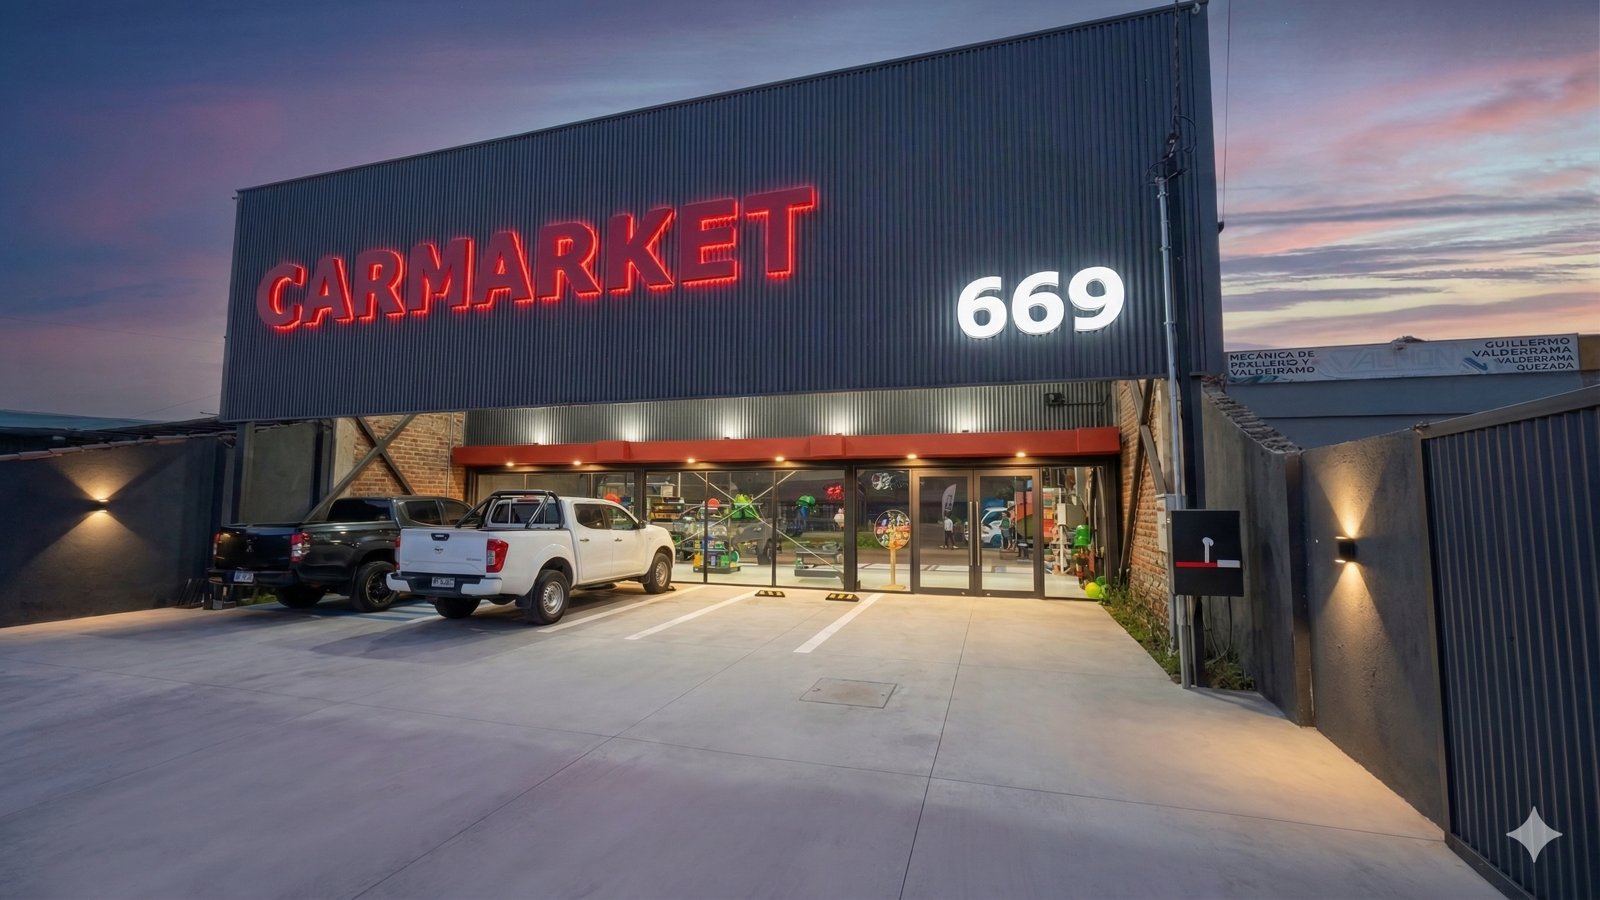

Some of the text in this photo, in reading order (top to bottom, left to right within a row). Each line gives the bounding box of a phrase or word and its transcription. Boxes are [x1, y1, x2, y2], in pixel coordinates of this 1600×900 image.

[256, 185, 817, 330] CARMARKET
[957, 266, 1125, 339] 669
[1484, 337, 1570, 349] GUILLERMO
[1230, 350, 1315, 361] MECÁNICA DE
[1472, 346, 1572, 358] VALDERRAMA
[1302, 358, 1310, 366] Y
[1497, 354, 1574, 364] VALDERRAMA
[1516, 362, 1574, 371] QUEZADA
